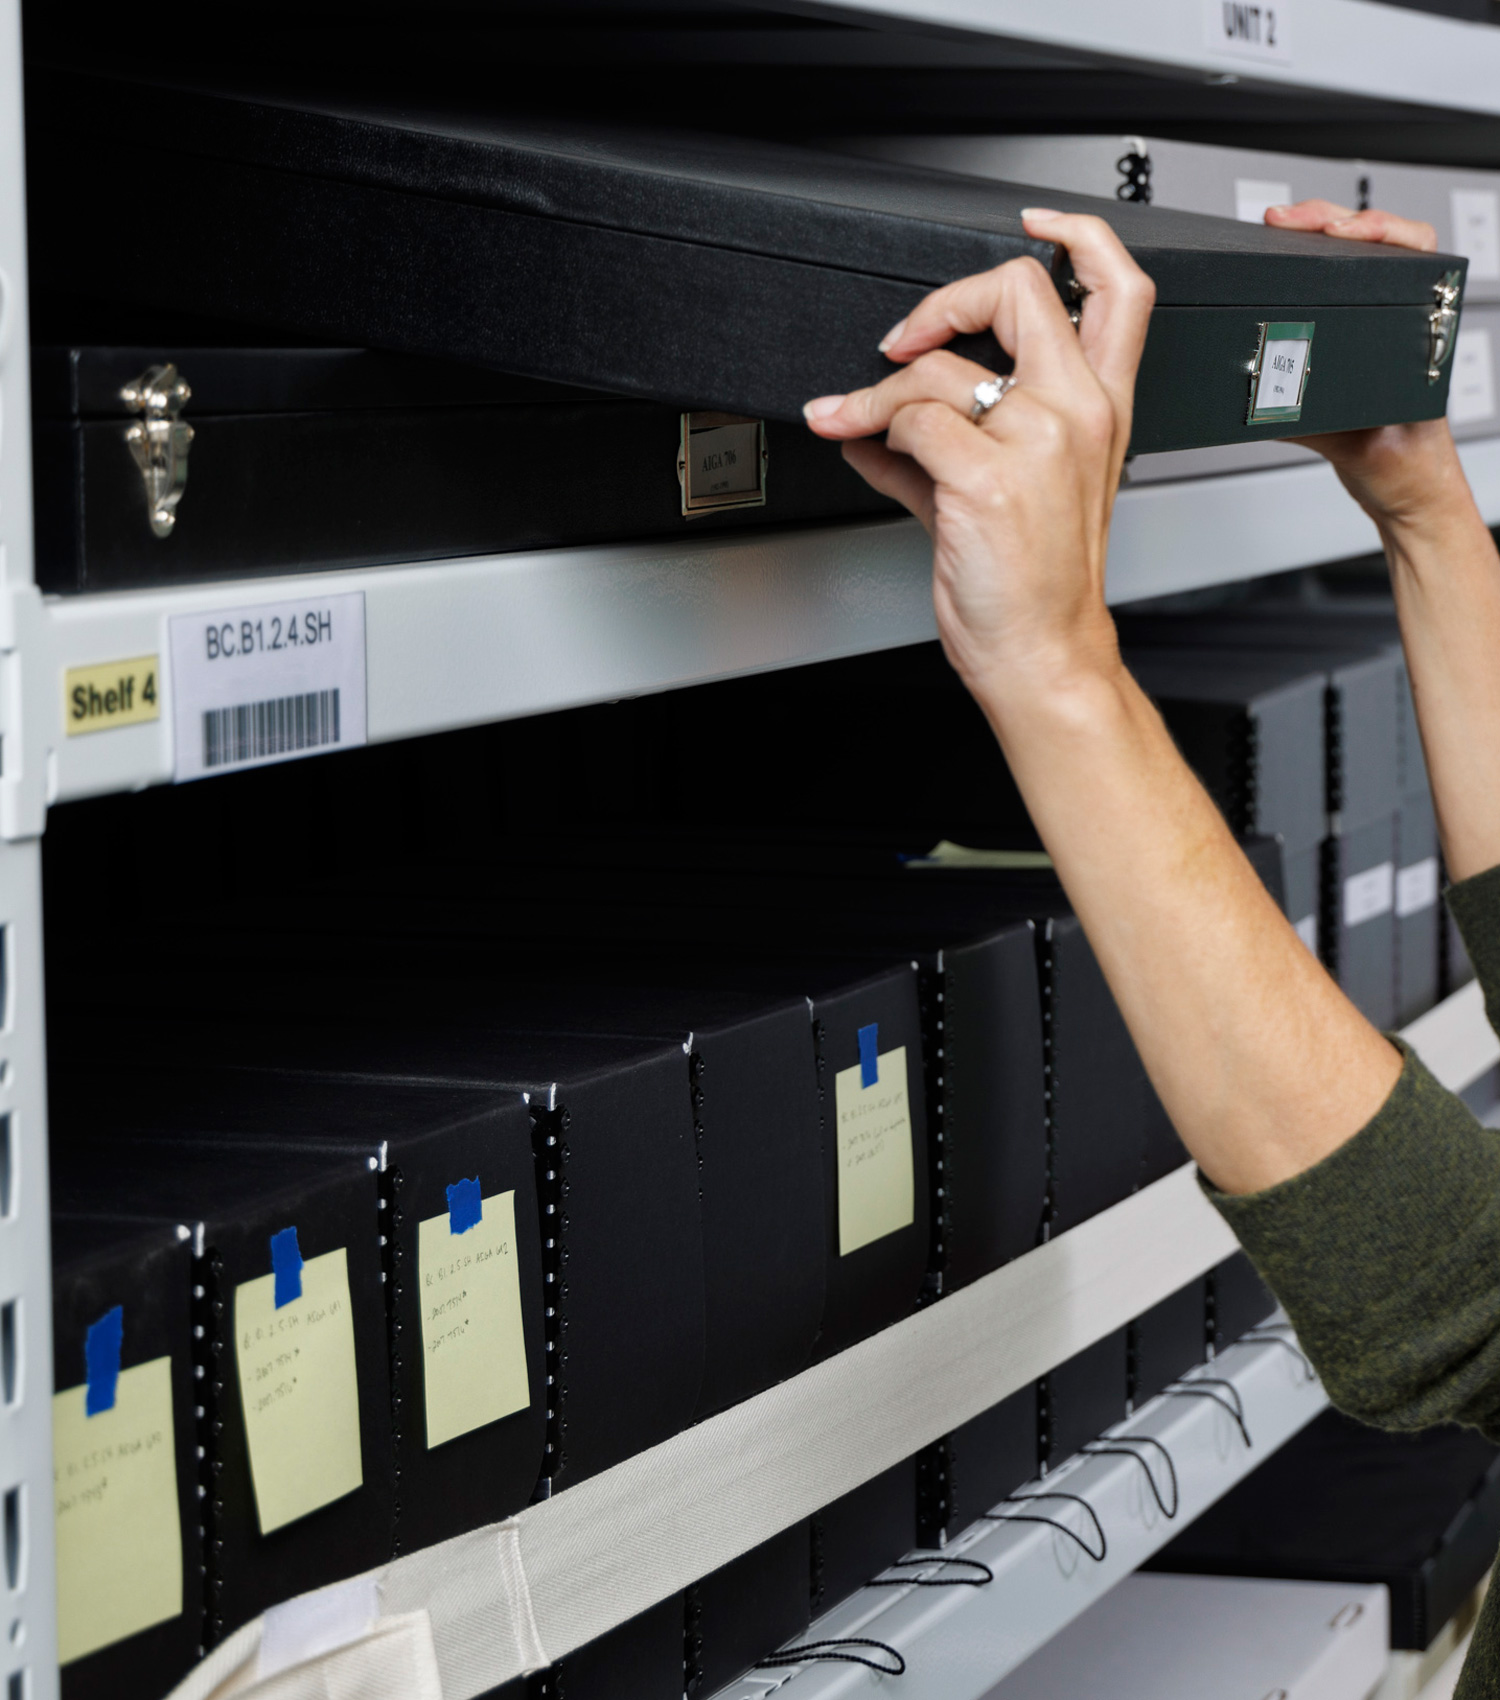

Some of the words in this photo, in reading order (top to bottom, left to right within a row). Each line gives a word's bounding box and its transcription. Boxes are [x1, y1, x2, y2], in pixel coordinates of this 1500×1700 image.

[1222, 1, 1261, 45] UNIT
[1266, 6, 1277, 49] 2
[702, 453, 722, 472] AIGA
[206, 609, 333, 661] BC.B1.2.4.SH
[71, 675, 136, 722] Shelf
[142, 672, 157, 706] 4
